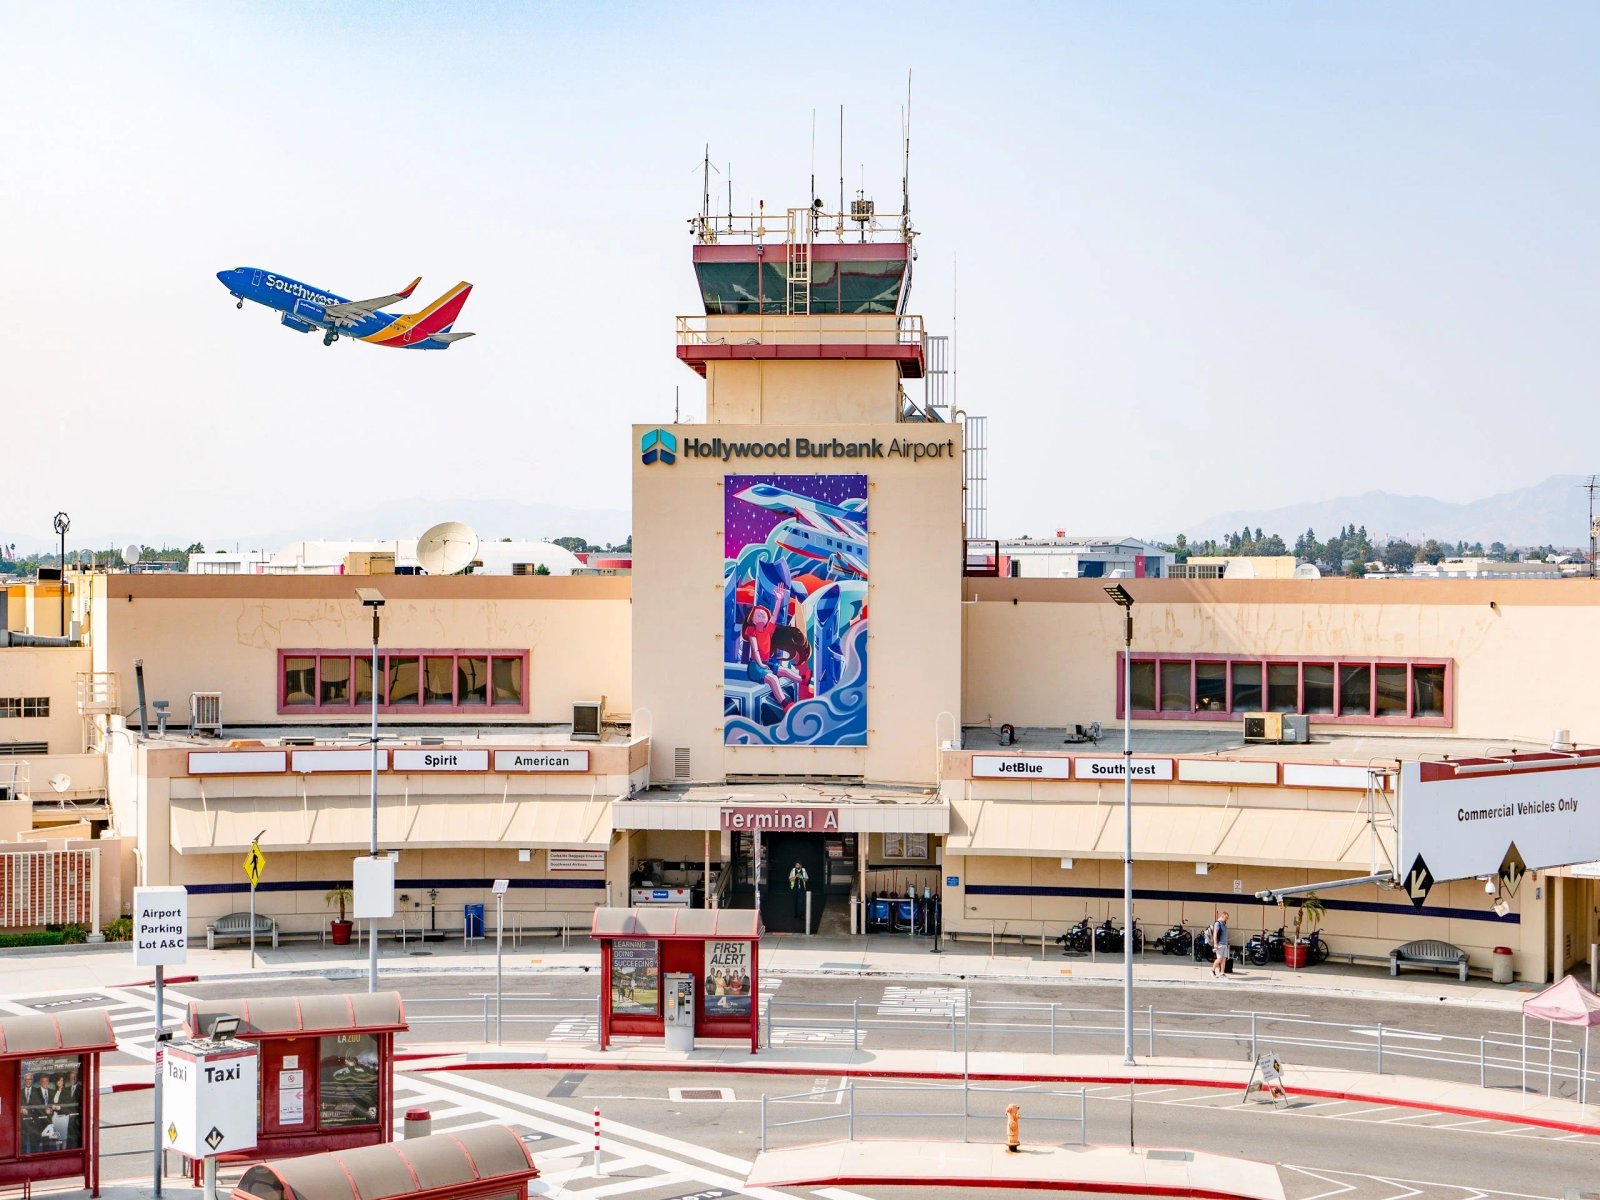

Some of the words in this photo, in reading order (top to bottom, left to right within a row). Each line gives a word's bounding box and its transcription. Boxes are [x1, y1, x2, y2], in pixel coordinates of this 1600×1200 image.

[266, 274, 340, 306] Southwest
[684, 438, 790, 462] Hollywood
[795, 438, 884, 458] Burbank
[887, 438, 954, 462] Airport
[424, 755, 458, 767] Spirit
[514, 756, 569, 766] American
[998, 762, 1043, 773] JetBlue
[1457, 803, 1514, 822] Commercial
[1517, 800, 1555, 816] Vehicles
[1558, 797, 1578, 812] Only
[721, 809, 813, 828] Terminal
[823, 811, 838, 828] A
[142, 909, 182, 919] Airport
[141, 924, 183, 935] Parking
[139, 940, 157, 949] Lot
[160, 939, 184, 949] A&C
[713, 943, 744, 954] FIRST
[710, 954, 746, 964] ALERT
[167, 1060, 187, 1082] Taxi
[204, 1064, 240, 1083] Taxi
